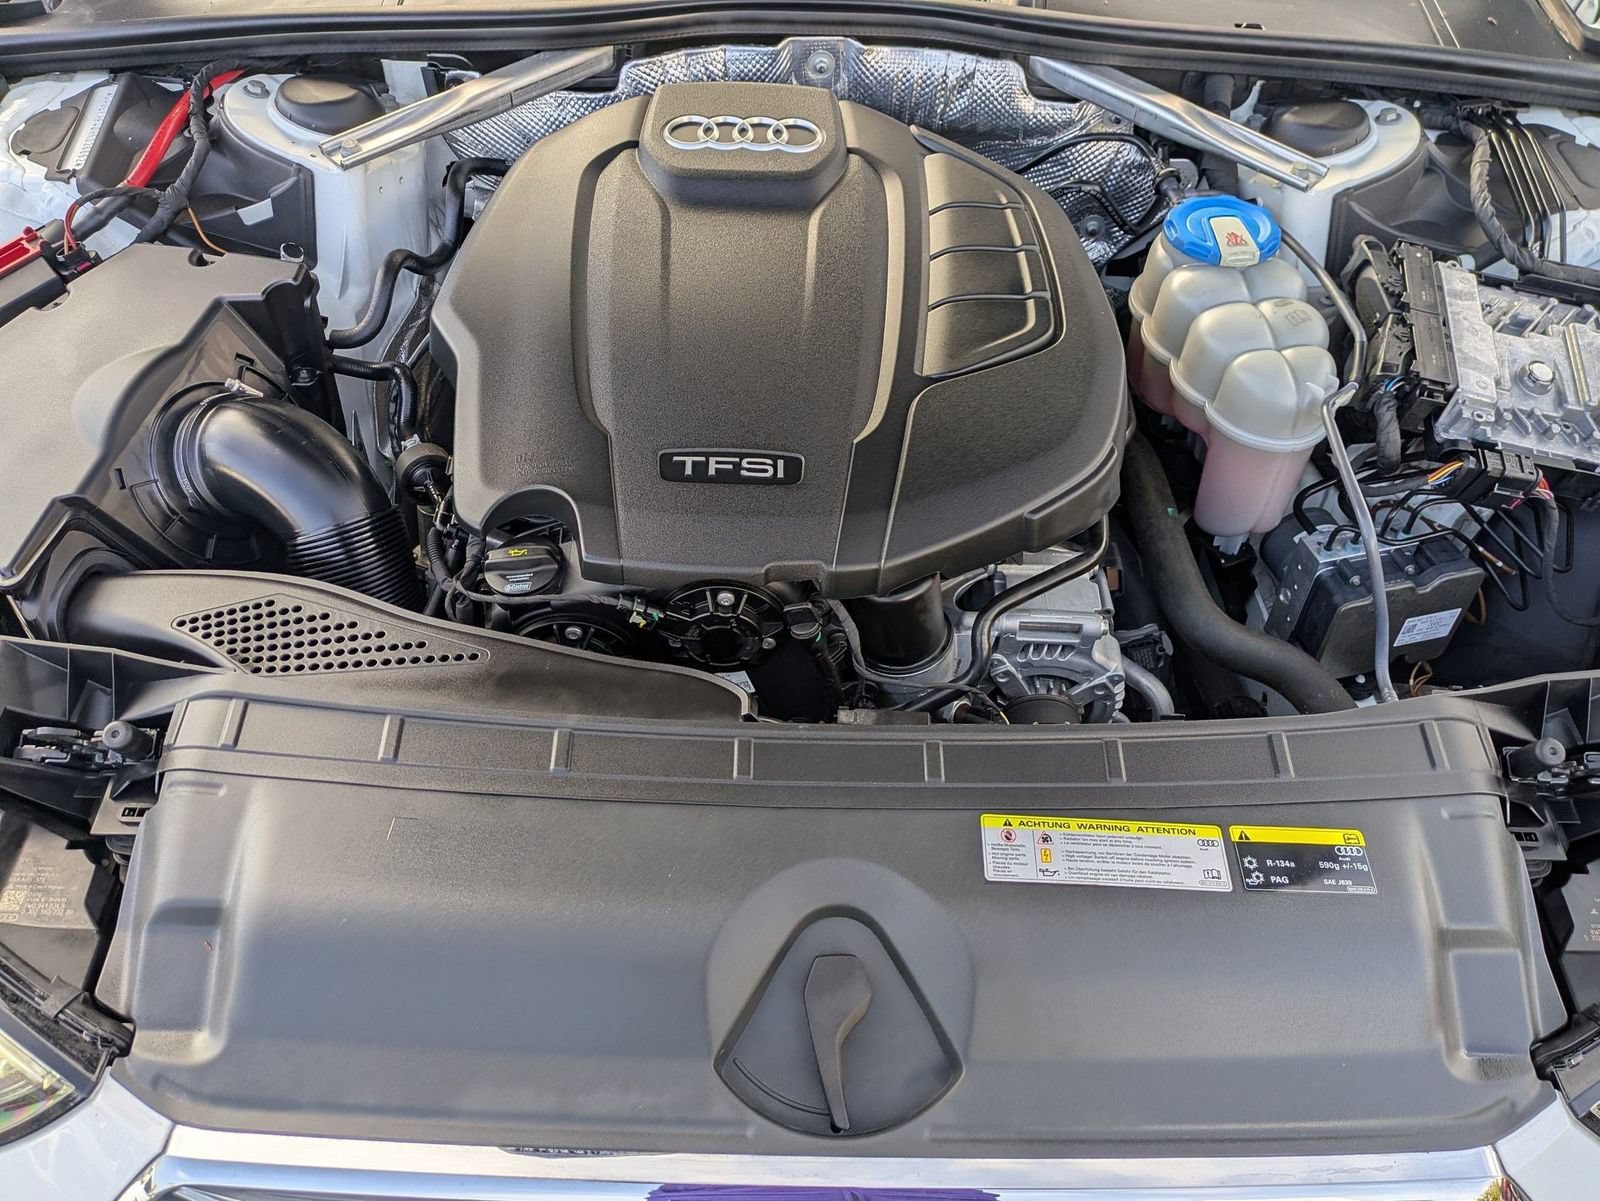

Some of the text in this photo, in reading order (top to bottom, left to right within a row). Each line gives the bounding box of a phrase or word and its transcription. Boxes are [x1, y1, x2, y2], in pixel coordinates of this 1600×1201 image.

[672, 456, 784, 479] TFSI
[1018, 820, 1196, 835] ACHTUNG WARNING ATTENTION
[1266, 860, 1369, 872] R-134a 590g +/-15g
[1270, 876, 1290, 884] PAG
